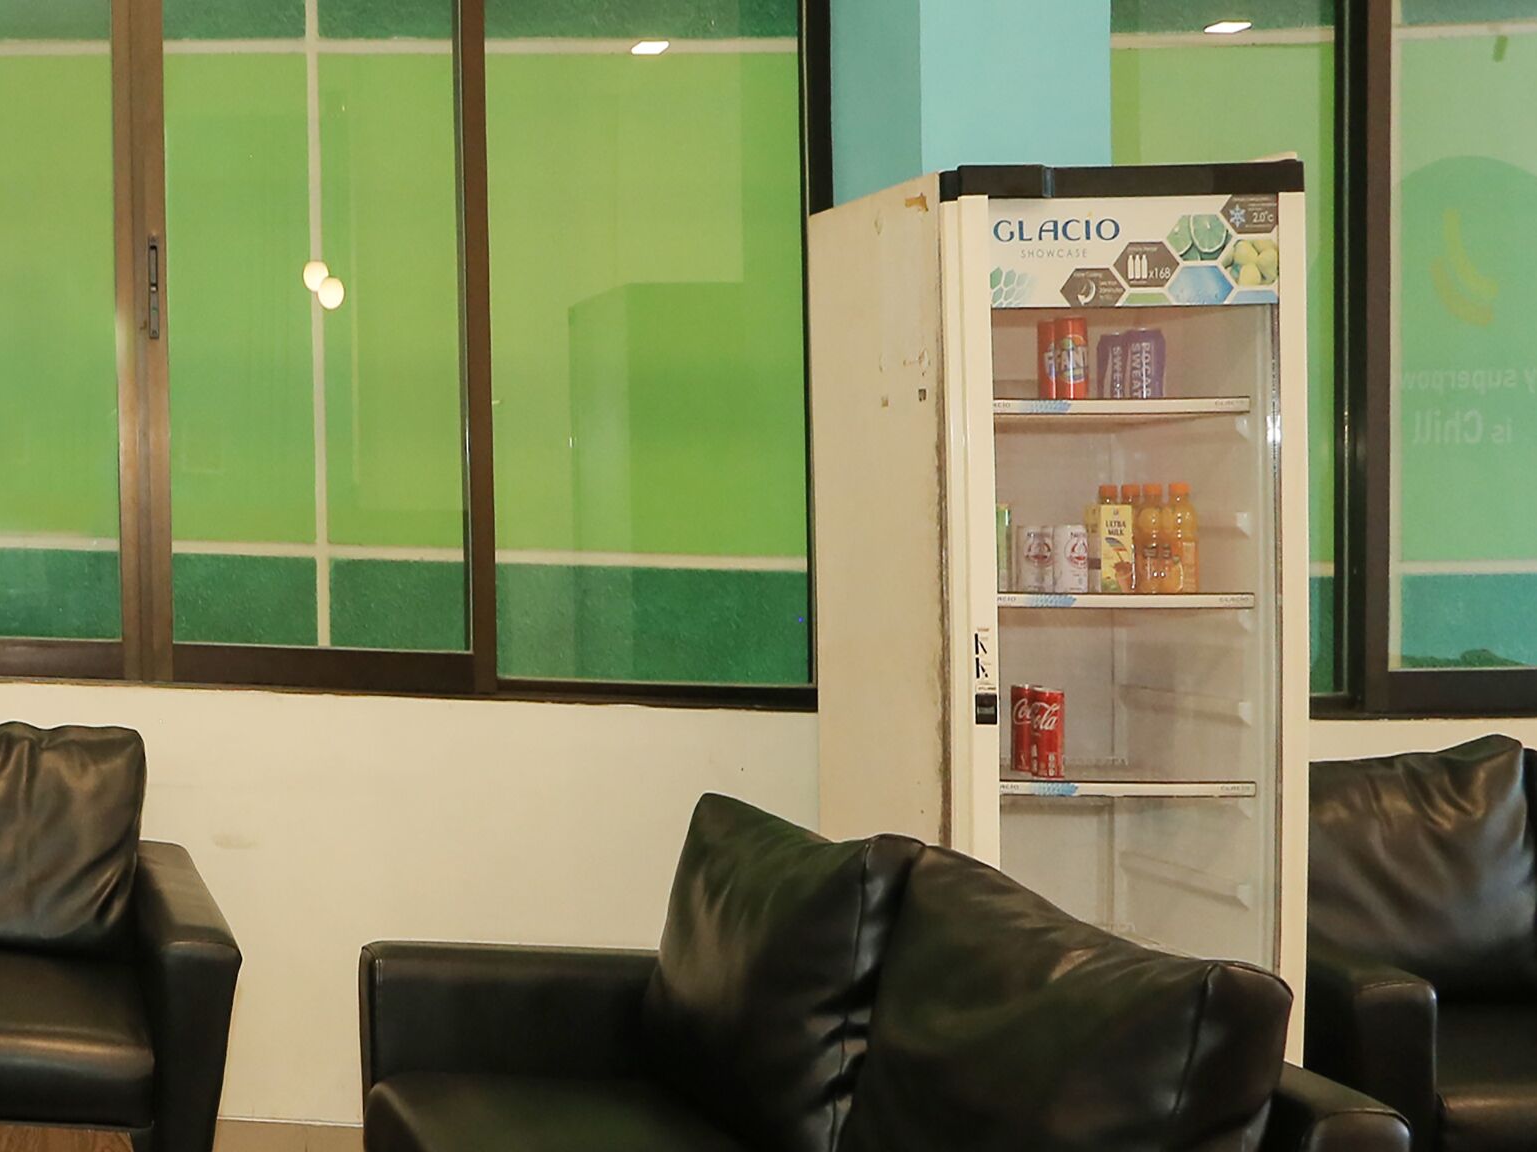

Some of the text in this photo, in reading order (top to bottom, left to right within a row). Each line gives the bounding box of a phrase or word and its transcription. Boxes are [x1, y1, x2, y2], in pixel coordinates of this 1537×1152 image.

[992, 218, 1121, 242] GLACIO
[1020, 248, 1088, 259] SHOWCASE
[1148, 266, 1171, 280] x168
